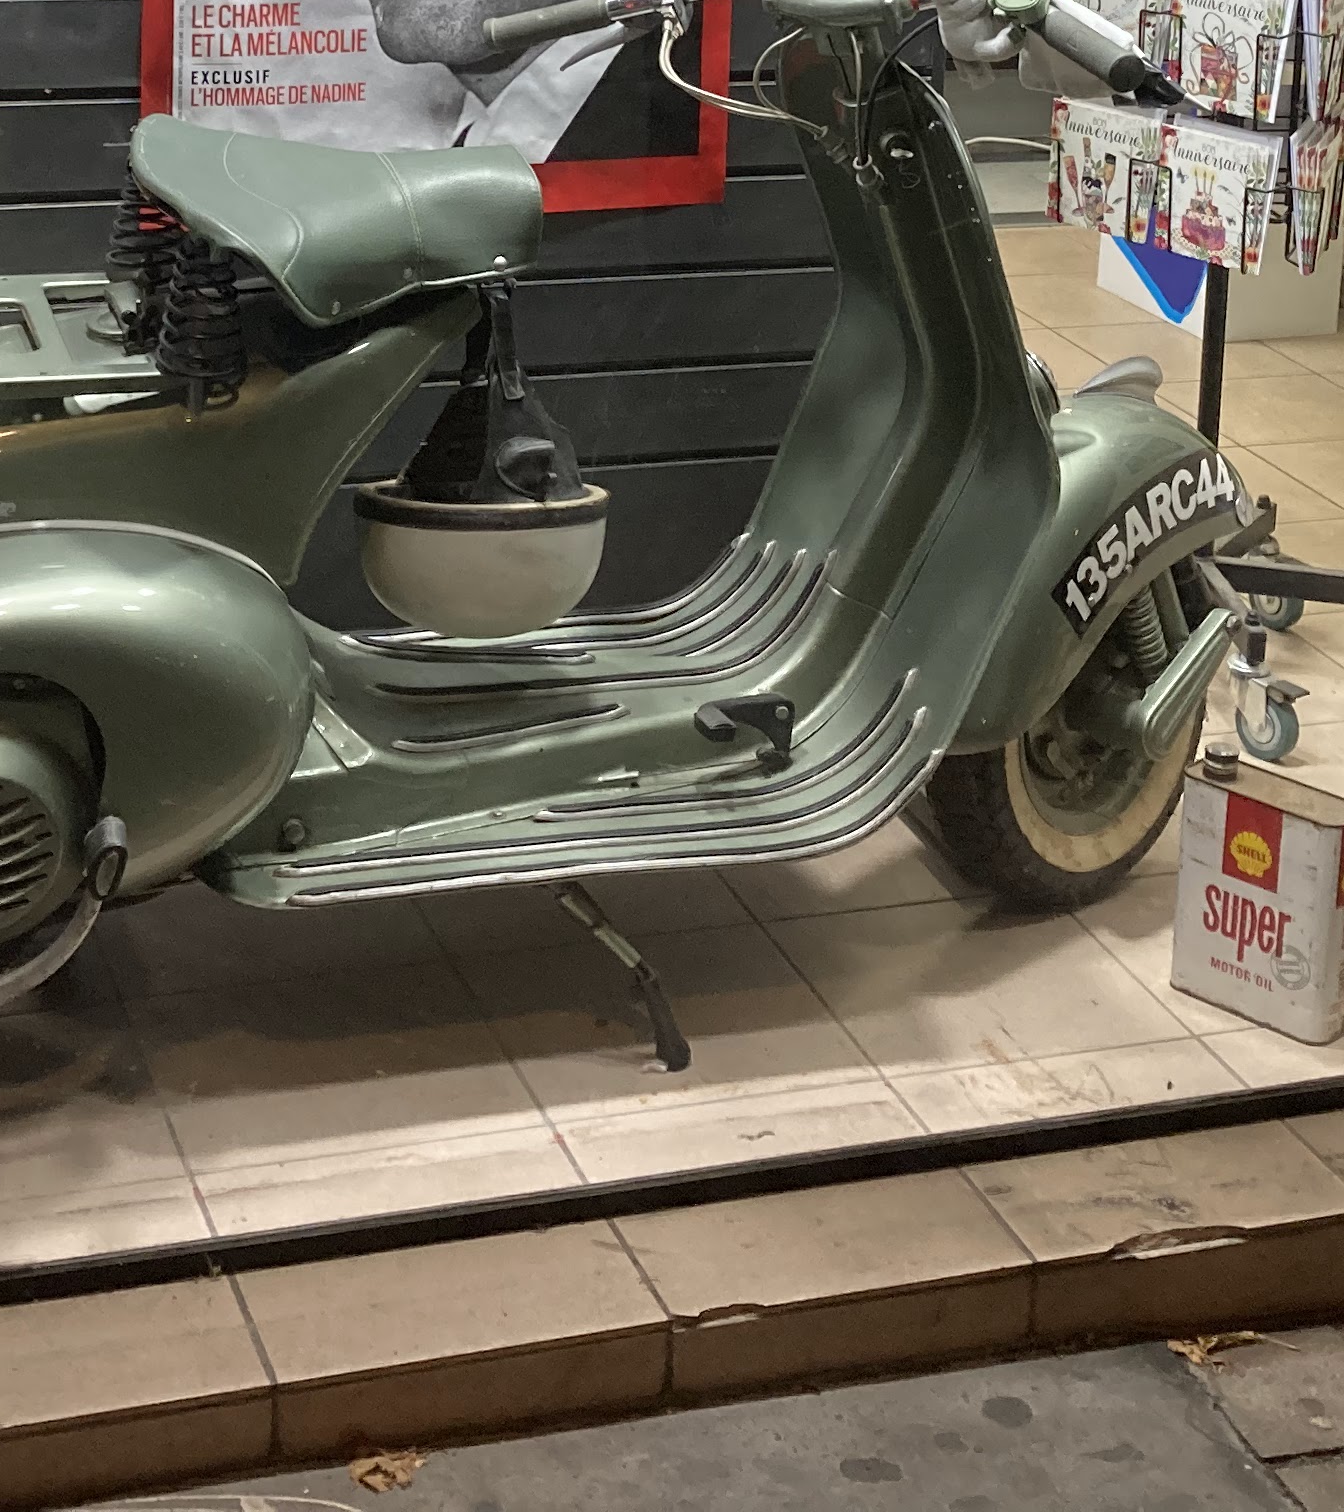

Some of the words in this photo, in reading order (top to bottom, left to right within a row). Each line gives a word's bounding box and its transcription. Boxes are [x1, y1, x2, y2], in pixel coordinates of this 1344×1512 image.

[192, 5, 216, 29] LE
[218, 2, 301, 28] CHARME
[191, 33, 216, 57] ET
[219, 32, 244, 57] LA
[247, 28, 368, 56] MÉLANCOLIE
[191, 69, 271, 86] EXCLUSIF
[191, 85, 285, 107] L'HOMMAGE
[288, 85, 308, 104] DE
[311, 82, 367, 103] NADINE
[1065, 453, 1235, 622] 135ARC44
[1236, 843, 1268, 864] SHELL
[1210, 956, 1251, 984] MOTOR
[1255, 972, 1274, 992] OIL
